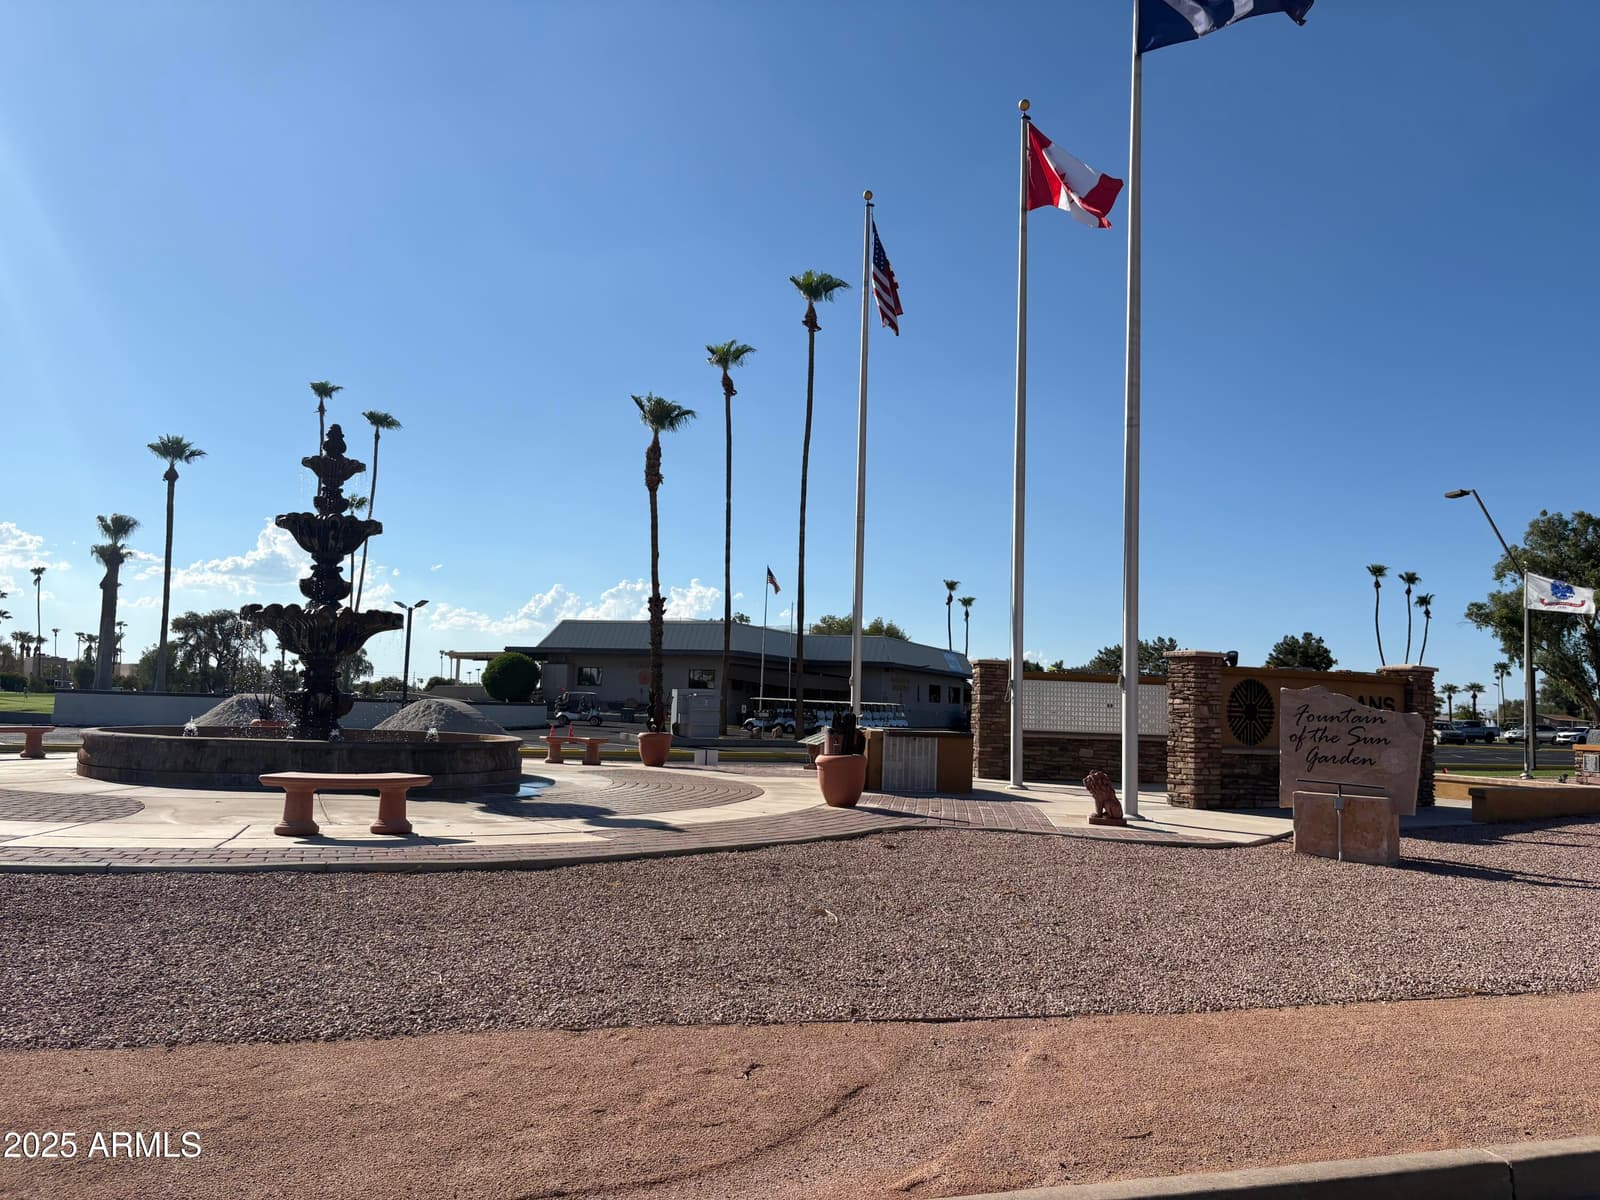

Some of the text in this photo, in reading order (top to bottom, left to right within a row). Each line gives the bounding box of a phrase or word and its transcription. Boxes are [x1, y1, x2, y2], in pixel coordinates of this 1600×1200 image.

[1294, 703, 1387, 726] Fountain
[1289, 726, 1391, 752] of the Sun
[1305, 747, 1377, 773] Garden
